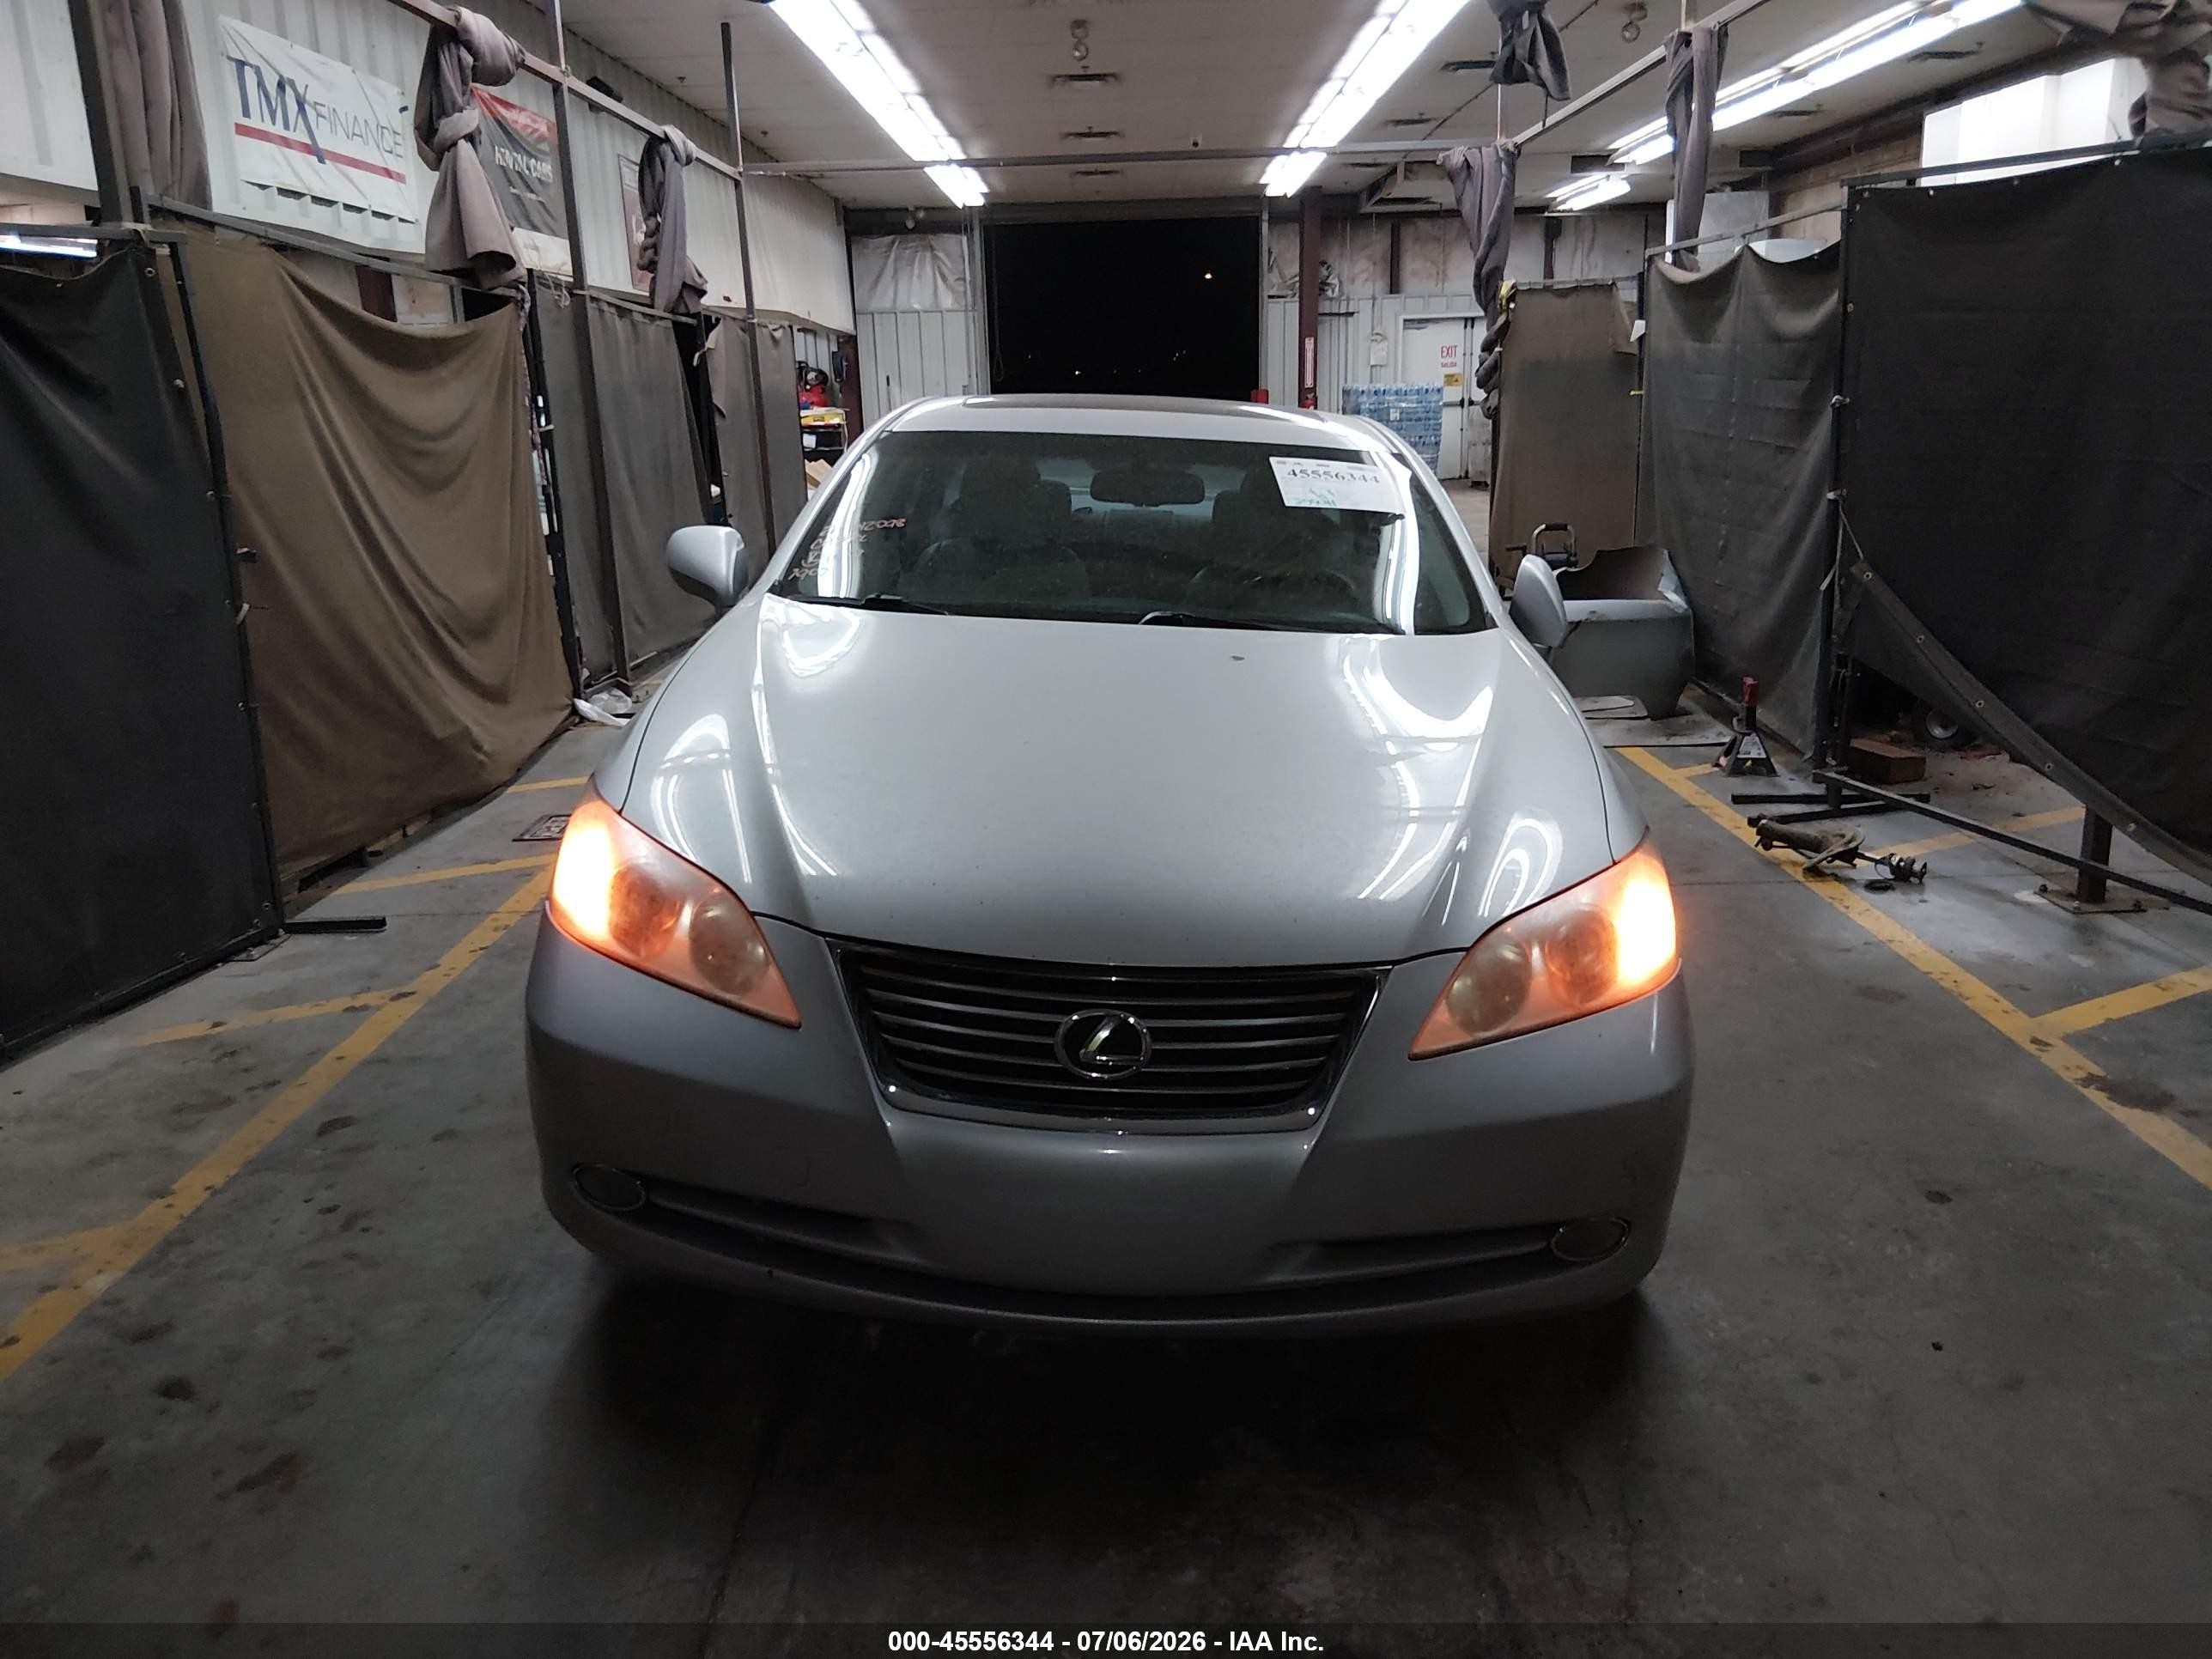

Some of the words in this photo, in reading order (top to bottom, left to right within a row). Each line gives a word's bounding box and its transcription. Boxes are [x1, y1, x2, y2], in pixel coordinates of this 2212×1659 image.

[227, 55, 326, 164] TMX
[313, 101, 404, 159] FINANCE
[1440, 345, 1458, 358] EXIT
[1287, 468, 1381, 484] 45556344
